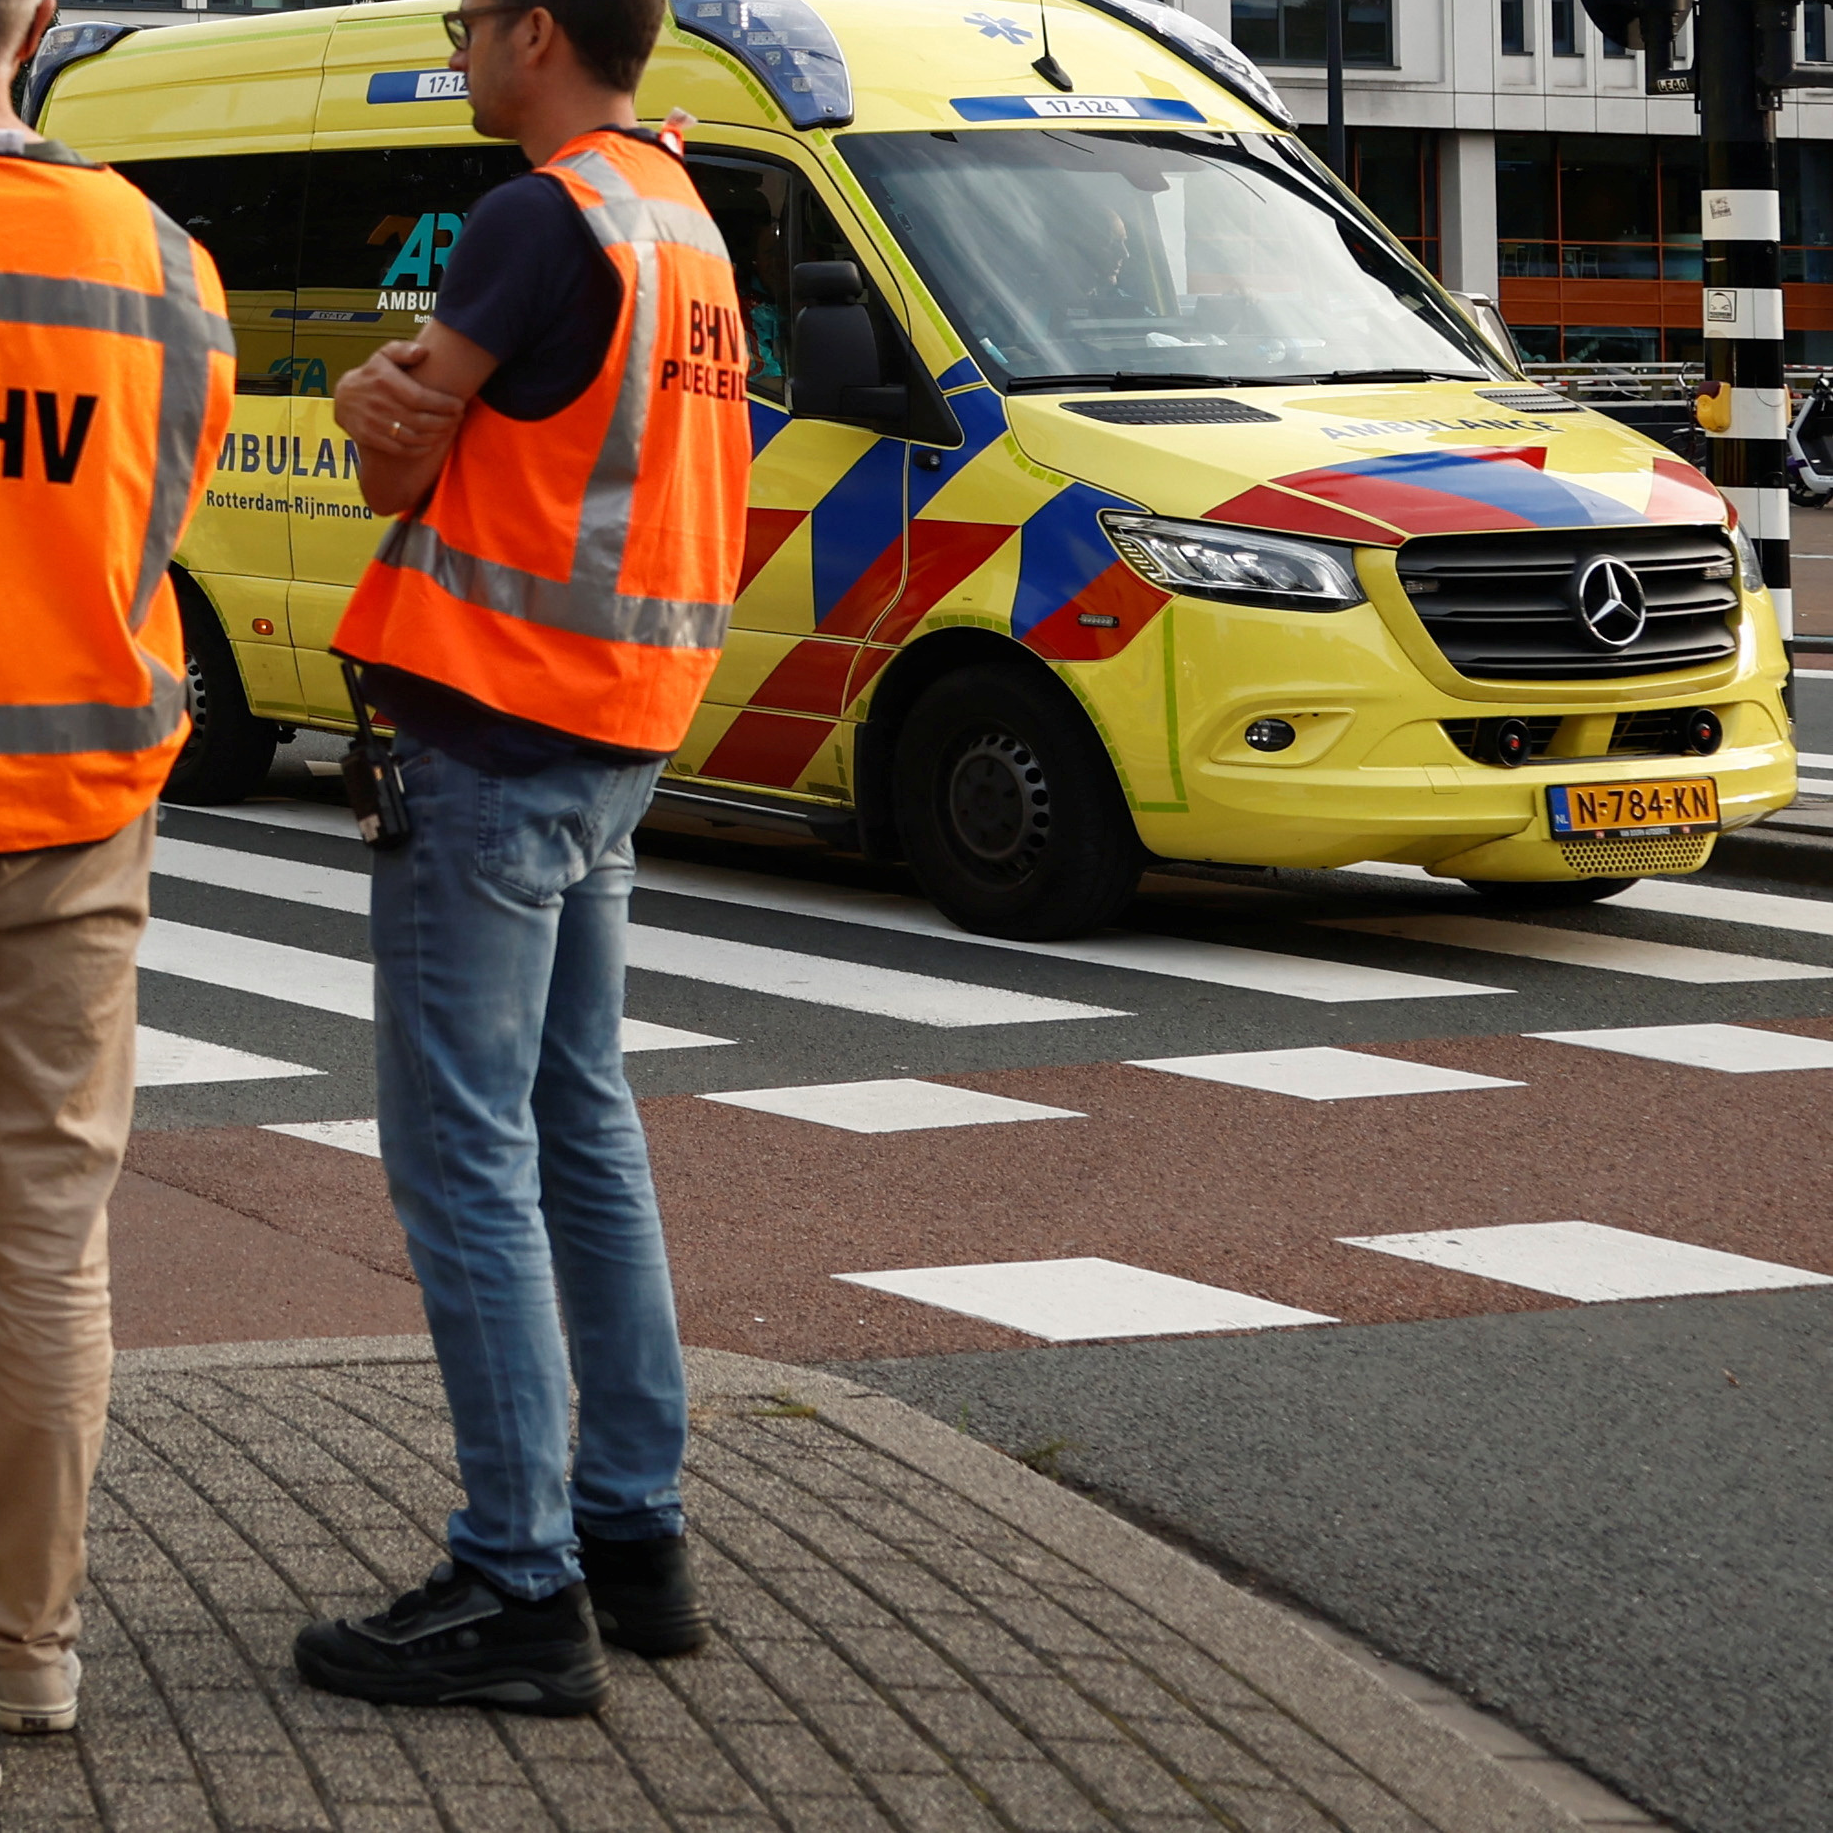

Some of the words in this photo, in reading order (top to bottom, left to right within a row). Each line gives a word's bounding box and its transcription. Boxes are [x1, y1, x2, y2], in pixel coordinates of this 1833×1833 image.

[429, 75, 467, 93] 17-12
[1046, 101, 1119, 113] 17-124
[690, 299, 739, 364] BHV
[1320, 419, 1566, 440] AMBULANCE
[217, 432, 361, 480] MBULAN
[1555, 814, 1569, 825] NL
[1577, 784, 1710, 824] N-784-KN
